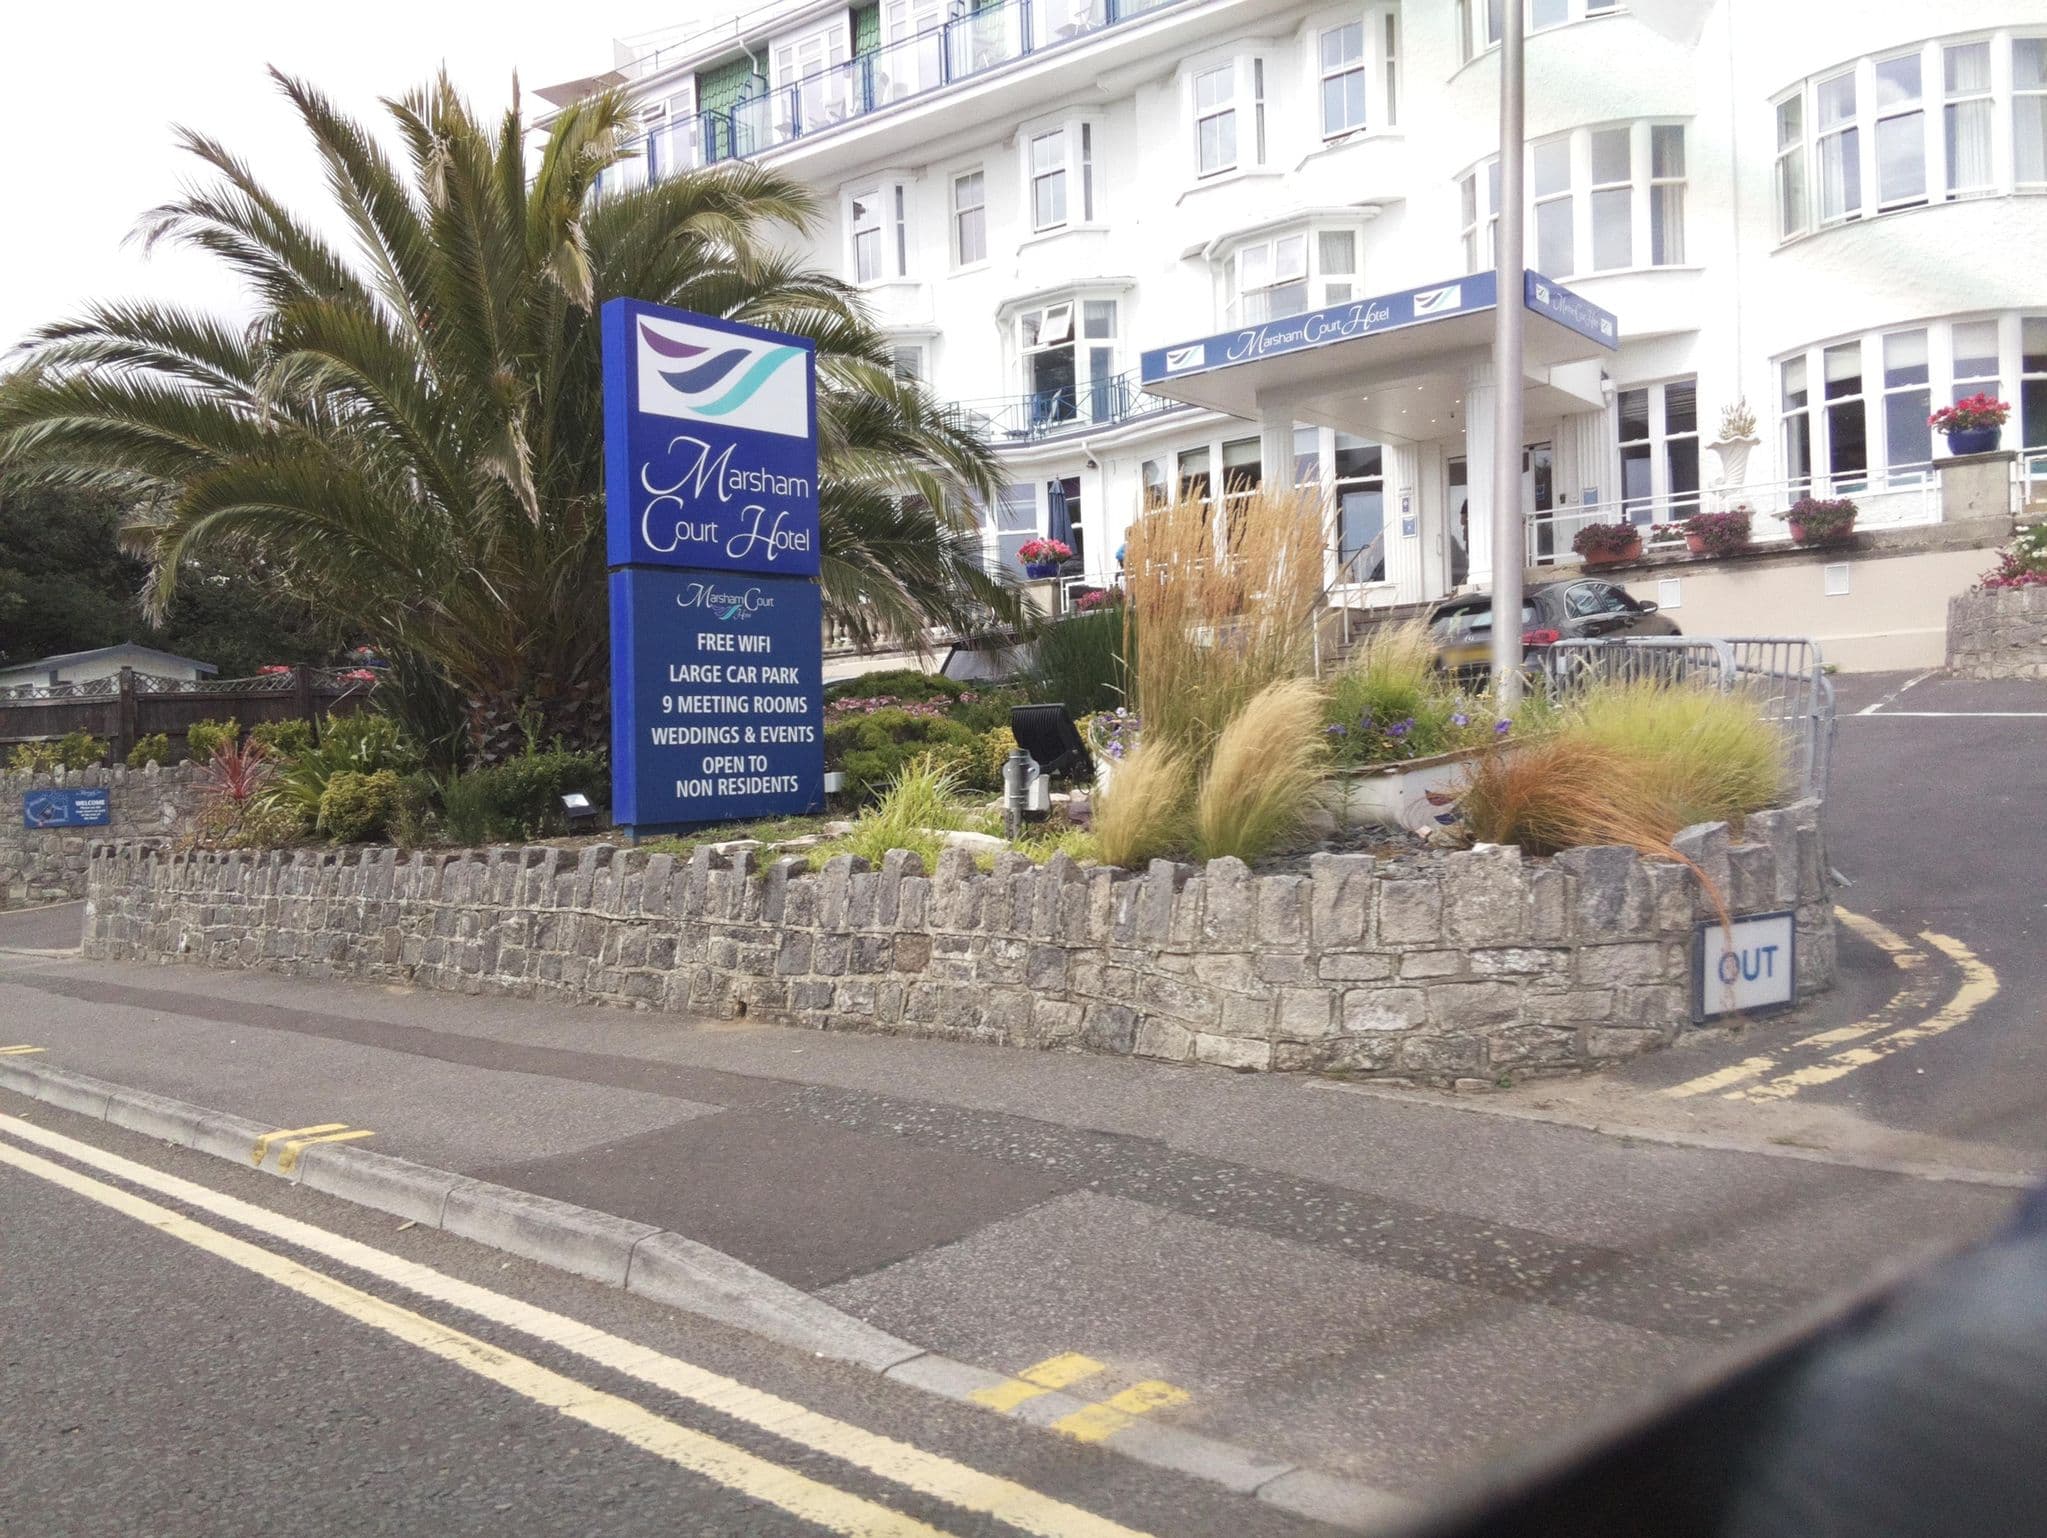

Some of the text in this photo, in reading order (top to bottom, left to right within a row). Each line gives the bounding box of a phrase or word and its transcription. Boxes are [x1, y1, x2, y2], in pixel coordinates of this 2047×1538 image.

[1227, 302, 1389, 360] Marsham Court Hotel
[641, 436, 808, 502] Marsham
[641, 495, 810, 561] Court Hotel
[676, 582, 774, 611] Marsham Court
[697, 633, 771, 653] FREE WIFI
[669, 664, 799, 684] LARGE CAR PARK
[662, 695, 807, 714] 9 MEETING ROOMS
[651, 726, 814, 745] WEDDINGS & EVENTS
[702, 755, 768, 775] OPEN TO
[676, 775, 799, 798] NON RESIDENTS
[1718, 944, 1779, 986] OUT
